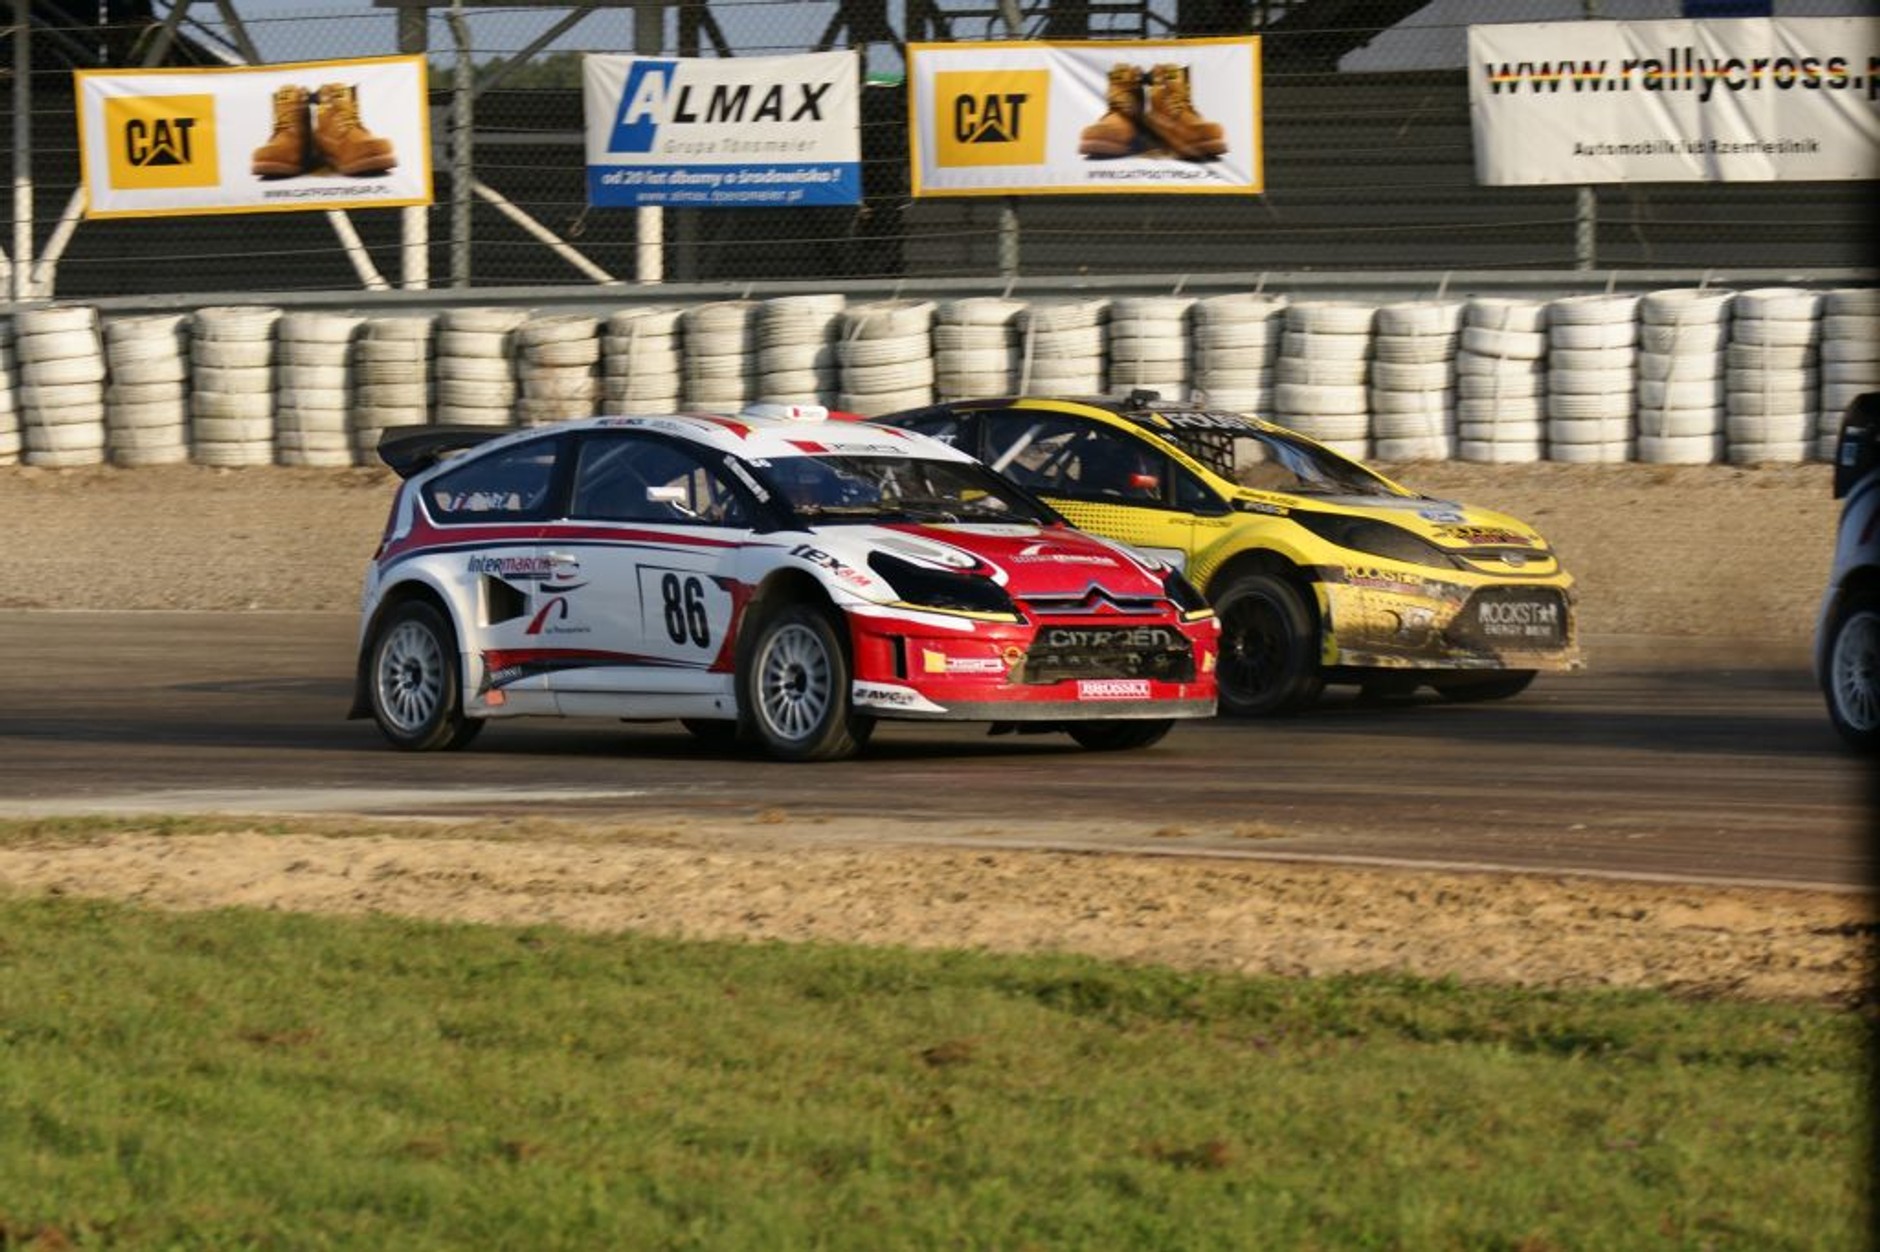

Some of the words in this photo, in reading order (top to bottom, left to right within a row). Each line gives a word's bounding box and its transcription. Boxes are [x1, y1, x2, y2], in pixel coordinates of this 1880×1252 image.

[622, 69, 833, 124] ALMAX
[955, 94, 1028, 143] CAT
[125, 118, 197, 166] CAT
[661, 572, 710, 649] 86
